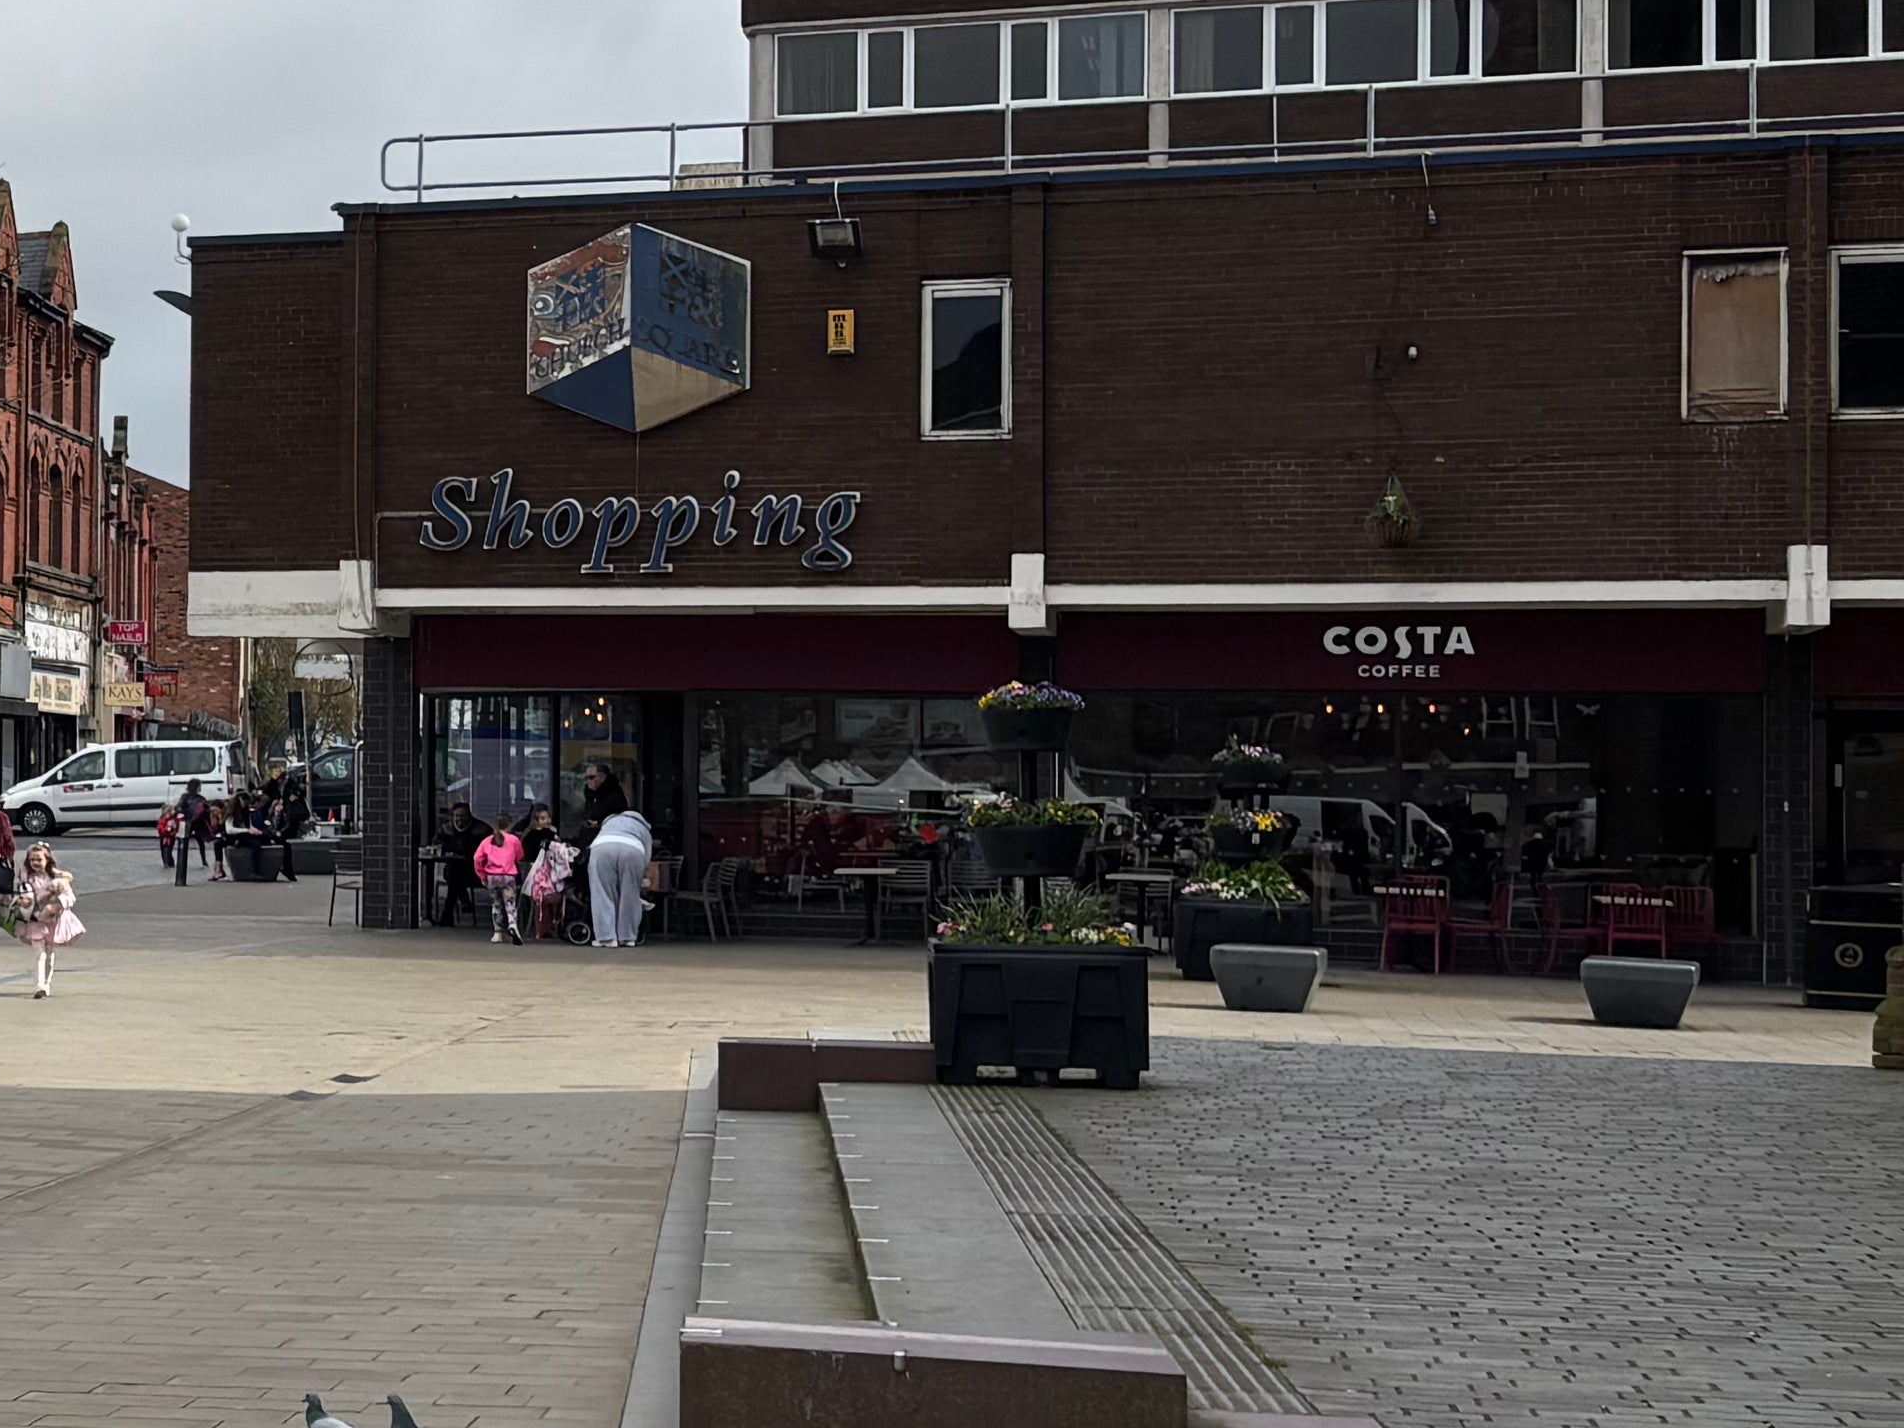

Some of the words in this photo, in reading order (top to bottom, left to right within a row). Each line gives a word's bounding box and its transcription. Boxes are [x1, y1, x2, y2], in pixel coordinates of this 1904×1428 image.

[419, 468, 861, 573] Shopping
[118, 623, 139, 632] TOP
[112, 633, 143, 641] NAILS
[1323, 626, 1475, 659] COSTA
[1357, 664, 1441, 678] COFFEE
[108, 685, 142, 698] KAYS
